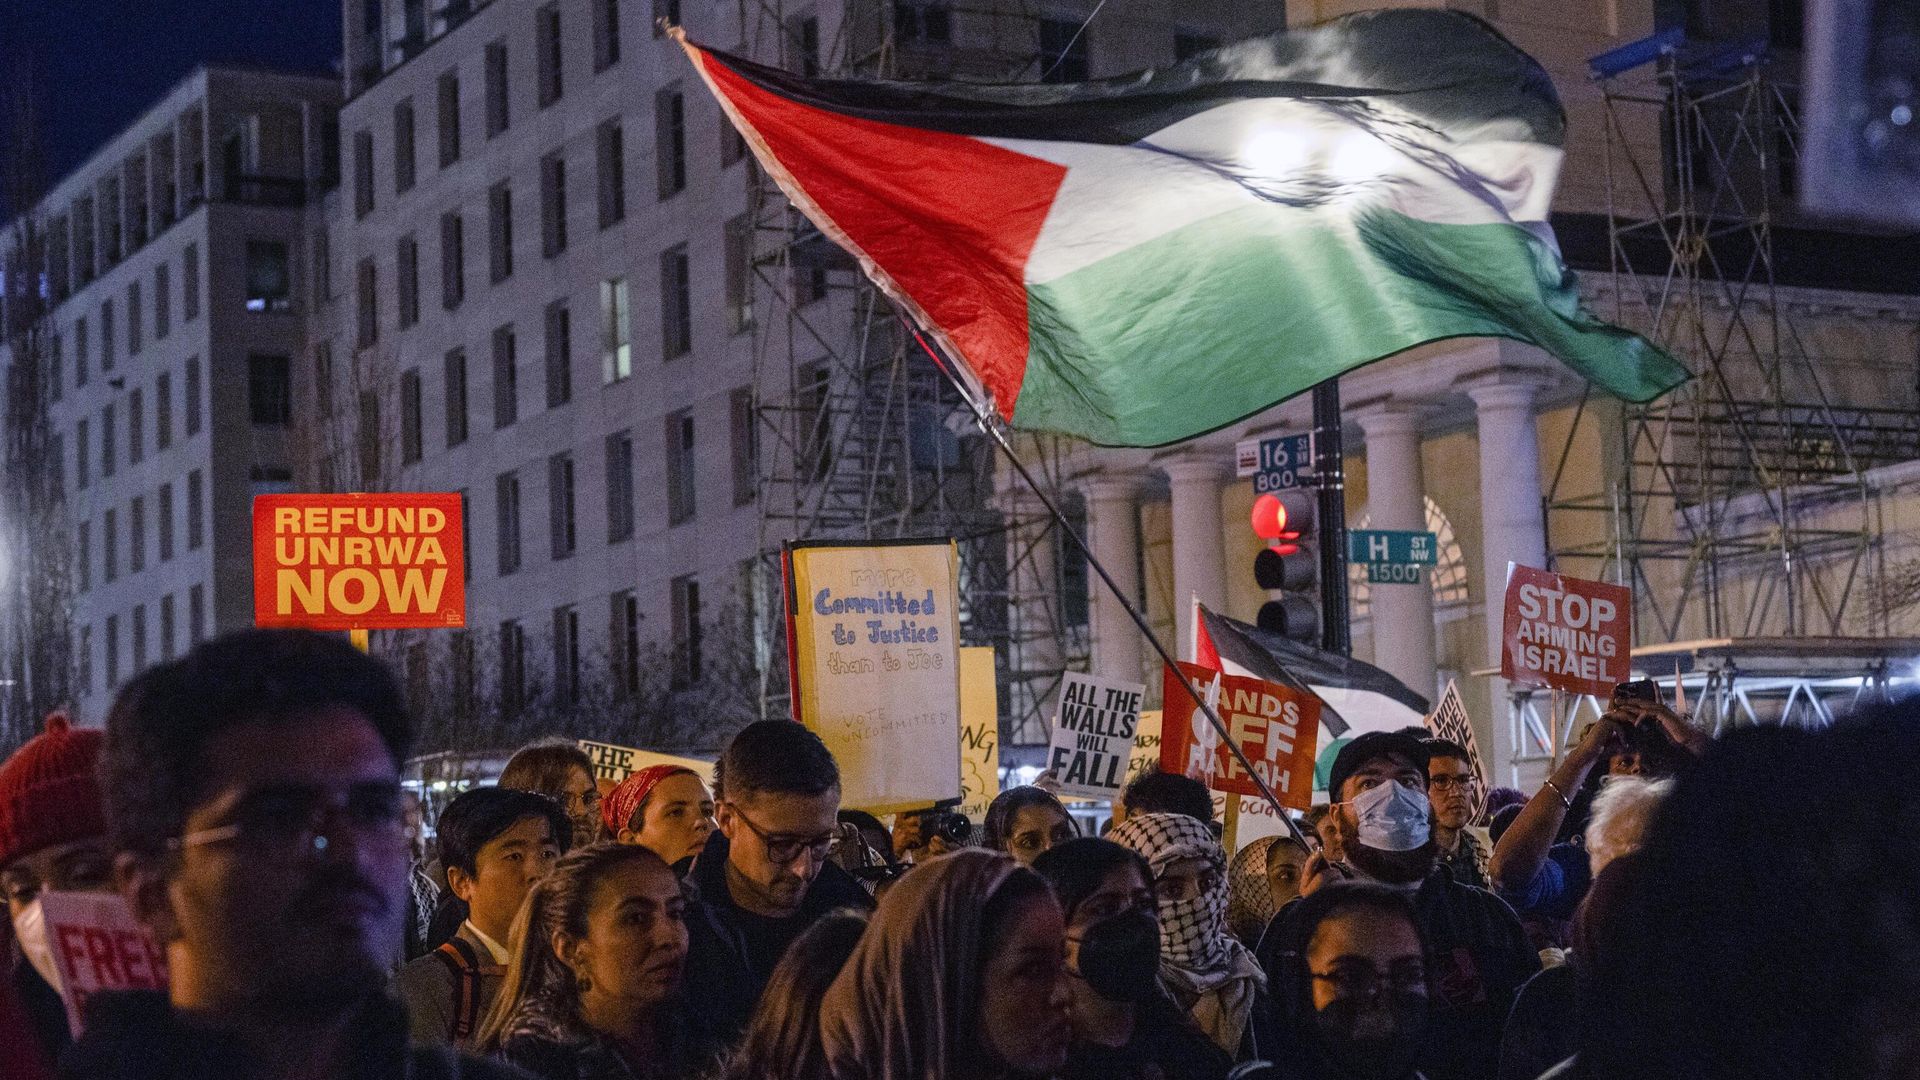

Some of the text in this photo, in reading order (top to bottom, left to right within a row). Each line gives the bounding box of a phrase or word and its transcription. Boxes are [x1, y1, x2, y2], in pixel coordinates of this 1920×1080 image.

[1263, 442, 1289, 468] 16
[1257, 470, 1294, 491] 800
[275, 507, 446, 534] REFUND
[275, 537, 448, 566] UNRWA
[1368, 535, 1389, 561] H
[1410, 536, 1428, 548] ST
[1410, 549, 1430, 561] NW
[1370, 564, 1418, 581] 1500
[276, 567, 448, 615] NOW
[814, 587, 936, 616] Committed
[1518, 583, 1617, 632] STOP
[831, 619, 939, 645] to Justice
[1517, 619, 1617, 658] ARMING
[827, 648, 943, 675] than to Joe
[1518, 643, 1617, 683] ISRAEL
[1064, 681, 1142, 715] ALL THE
[841, 707, 886, 728] VOTE
[1061, 702, 1136, 739] WALLS
[583, 743, 634, 770] THE
[1076, 733, 1109, 753] WILL
[1050, 746, 1120, 789] FALL
